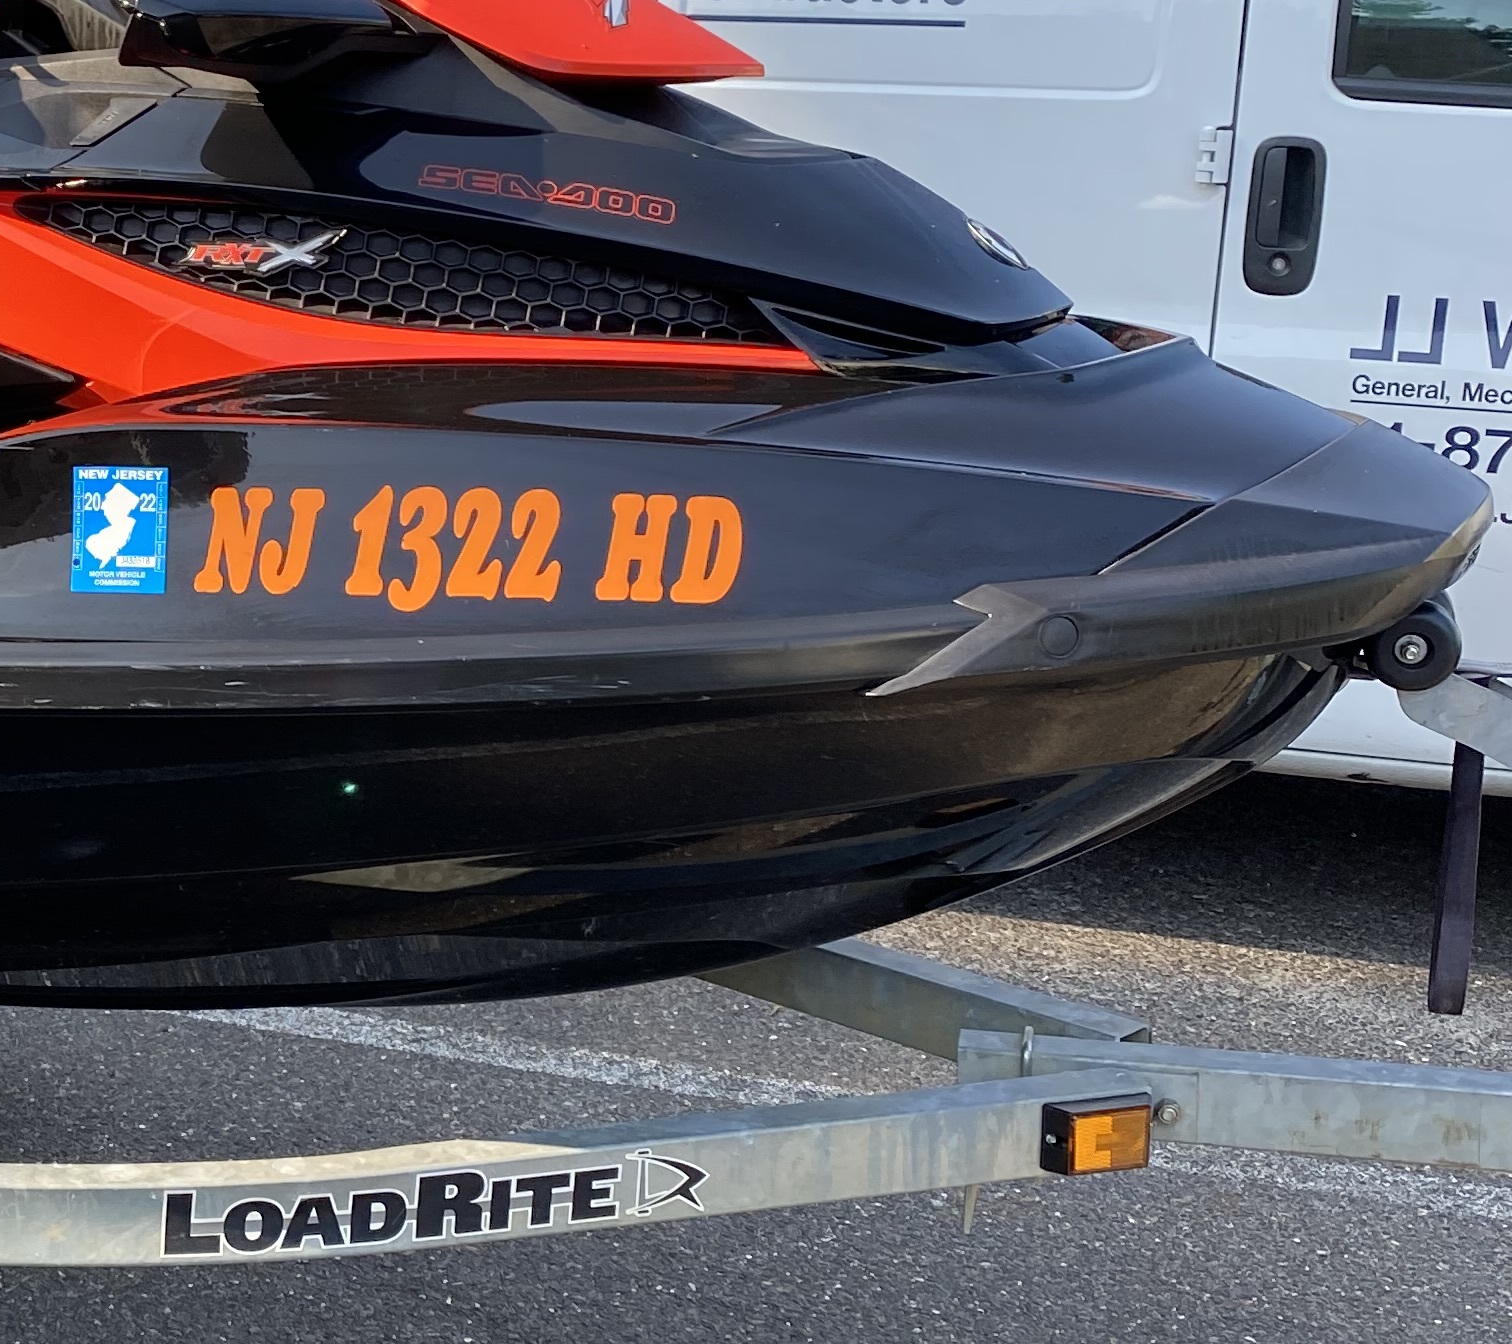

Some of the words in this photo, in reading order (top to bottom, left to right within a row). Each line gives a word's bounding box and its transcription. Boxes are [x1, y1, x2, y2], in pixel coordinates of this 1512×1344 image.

[1352, 374, 1451, 404] General,
[78, 469, 109, 480] NEW
[111, 469, 164, 481] JERSEY
[84, 491, 101, 512] 20
[139, 492, 157, 513] 22
[193, 484, 326, 595] NJ
[344, 484, 562, 613] 1322
[595, 492, 744, 605] HD
[88, 570, 115, 578] MOTOR
[115, 571, 146, 579] VEHICLE
[93, 578, 141, 587] COMMISSION
[160, 1164, 623, 1258] LOADRITE
